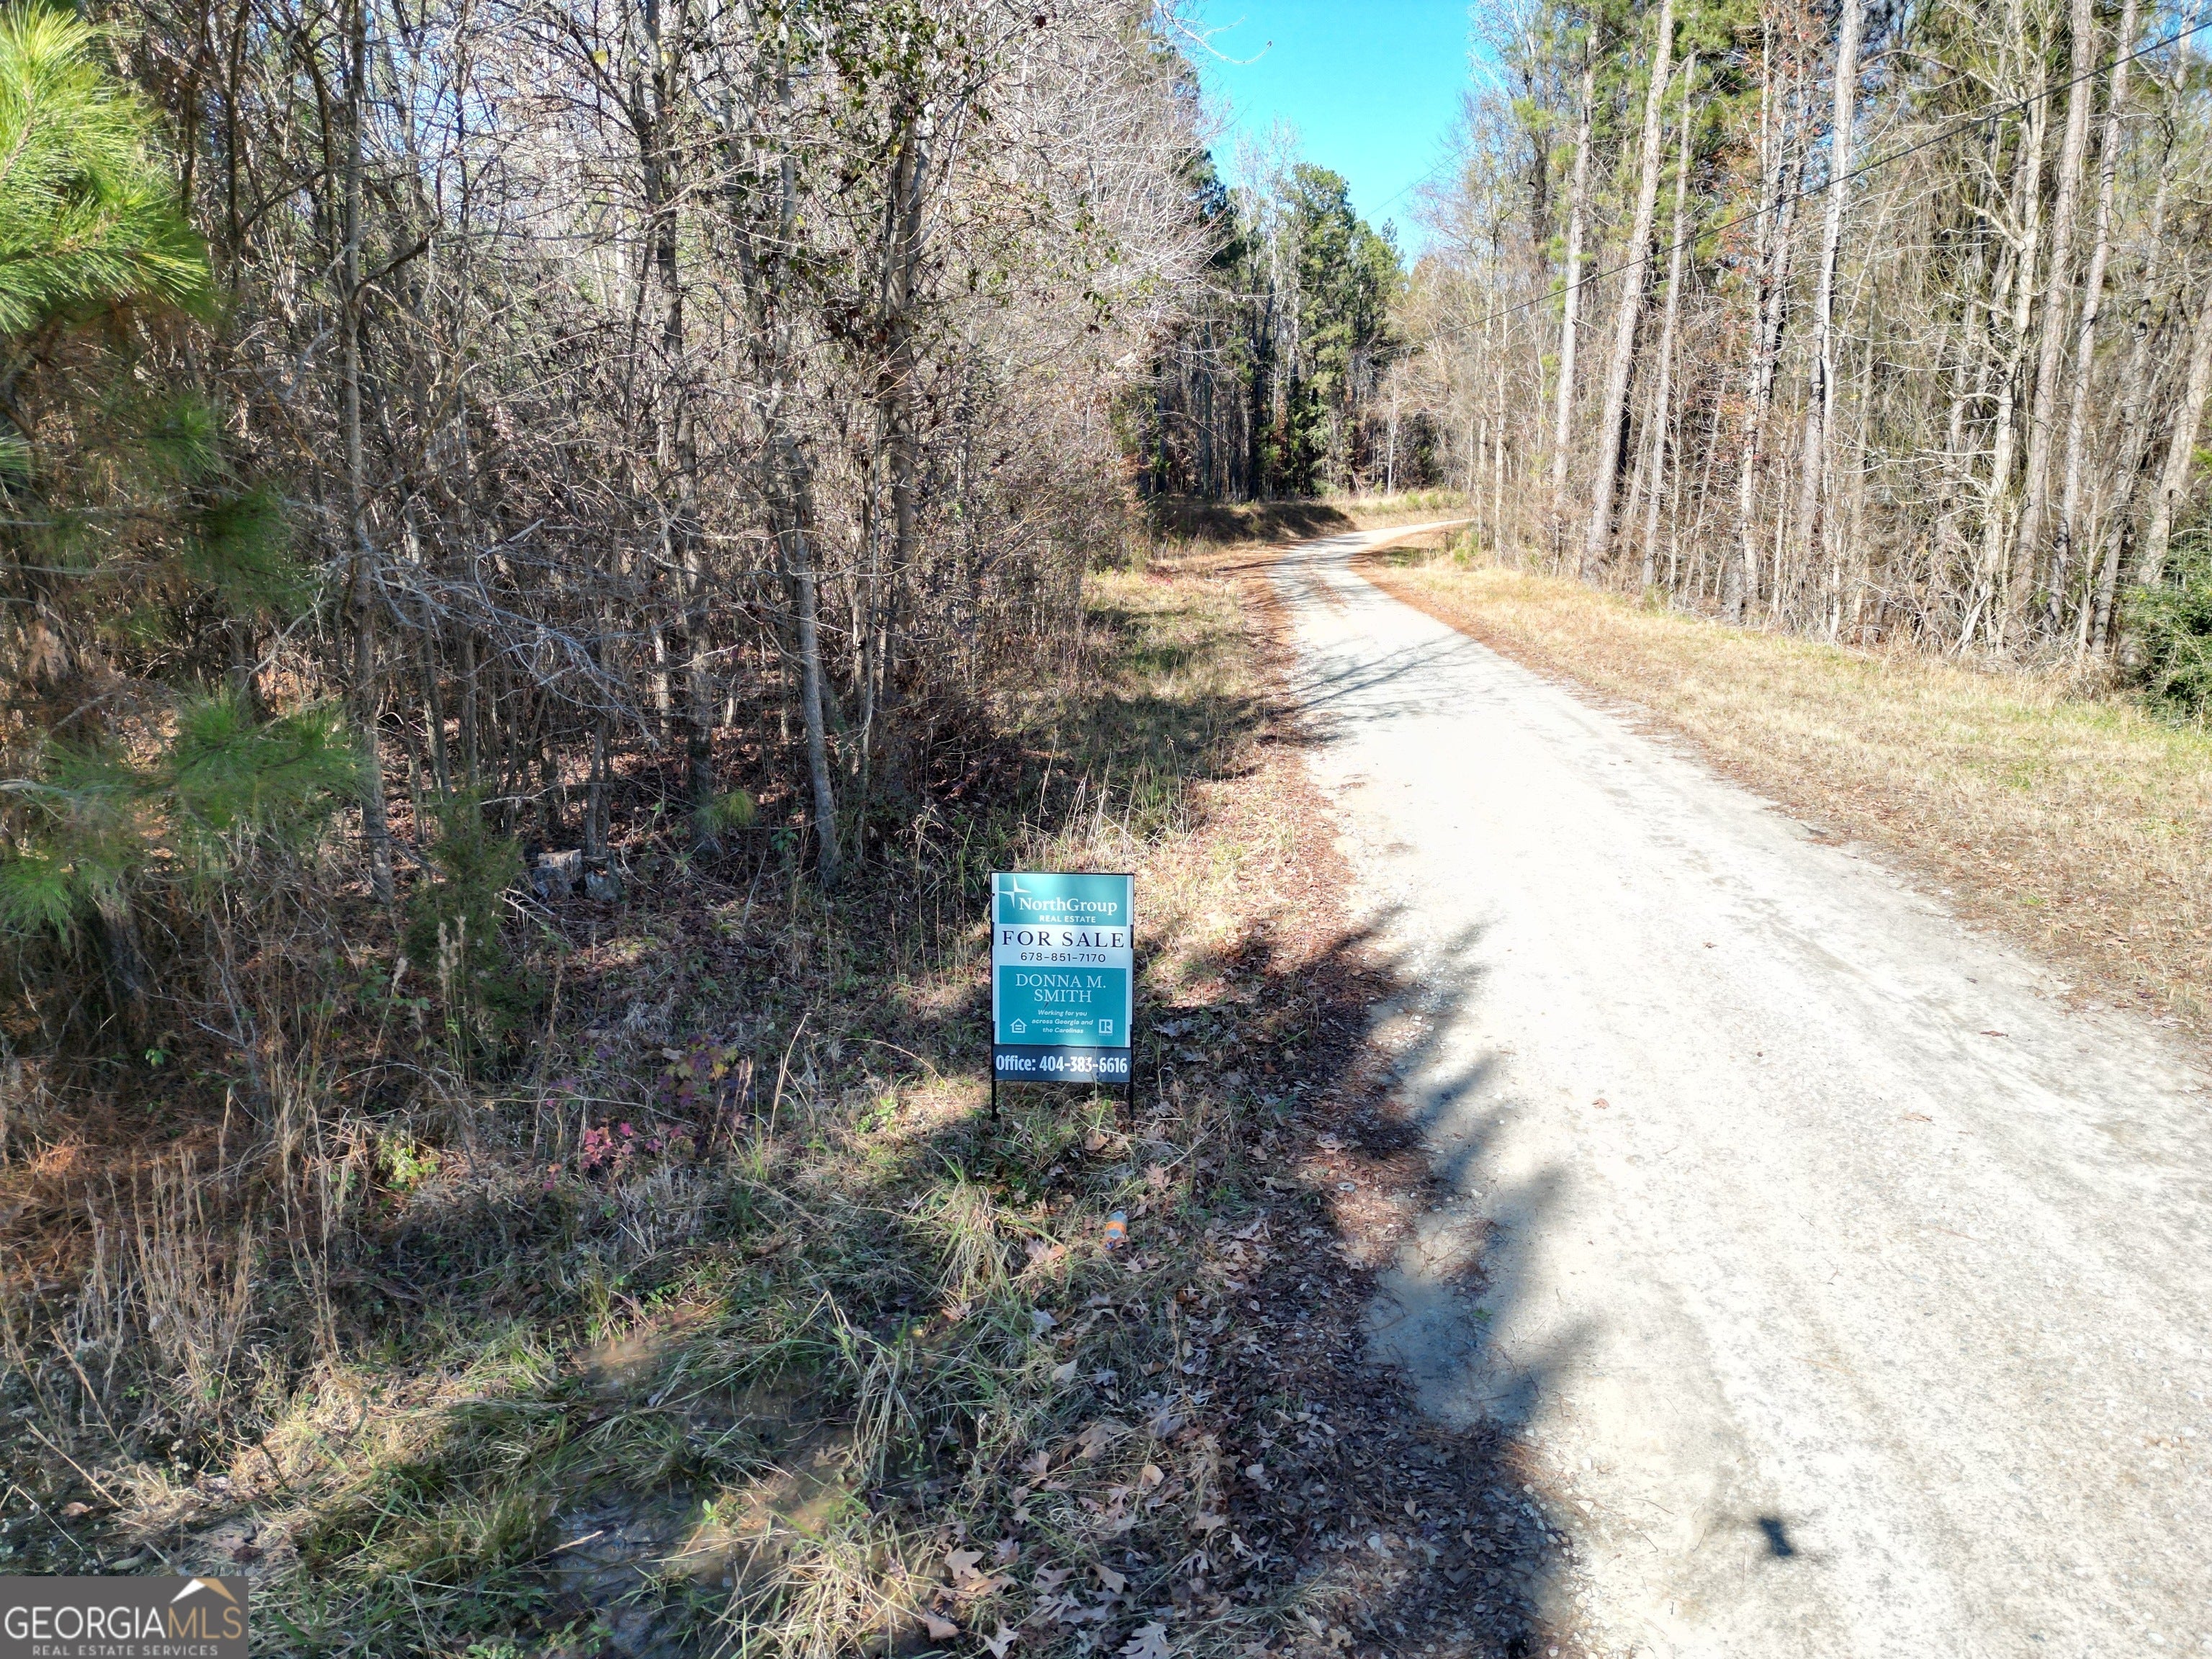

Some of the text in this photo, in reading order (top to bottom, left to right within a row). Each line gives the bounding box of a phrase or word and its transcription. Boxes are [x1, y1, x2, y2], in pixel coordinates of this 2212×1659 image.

[1019, 897, 1118, 915] NorthGroup
[1002, 930, 1124, 948] FOR SALE
[1020, 952, 1106, 963] 678-851-7170
[1015, 974, 1106, 989] DONNA M.
[1034, 989, 1092, 1002] SMITH
[996, 1055, 1128, 1073] Office: 404-383-6616
